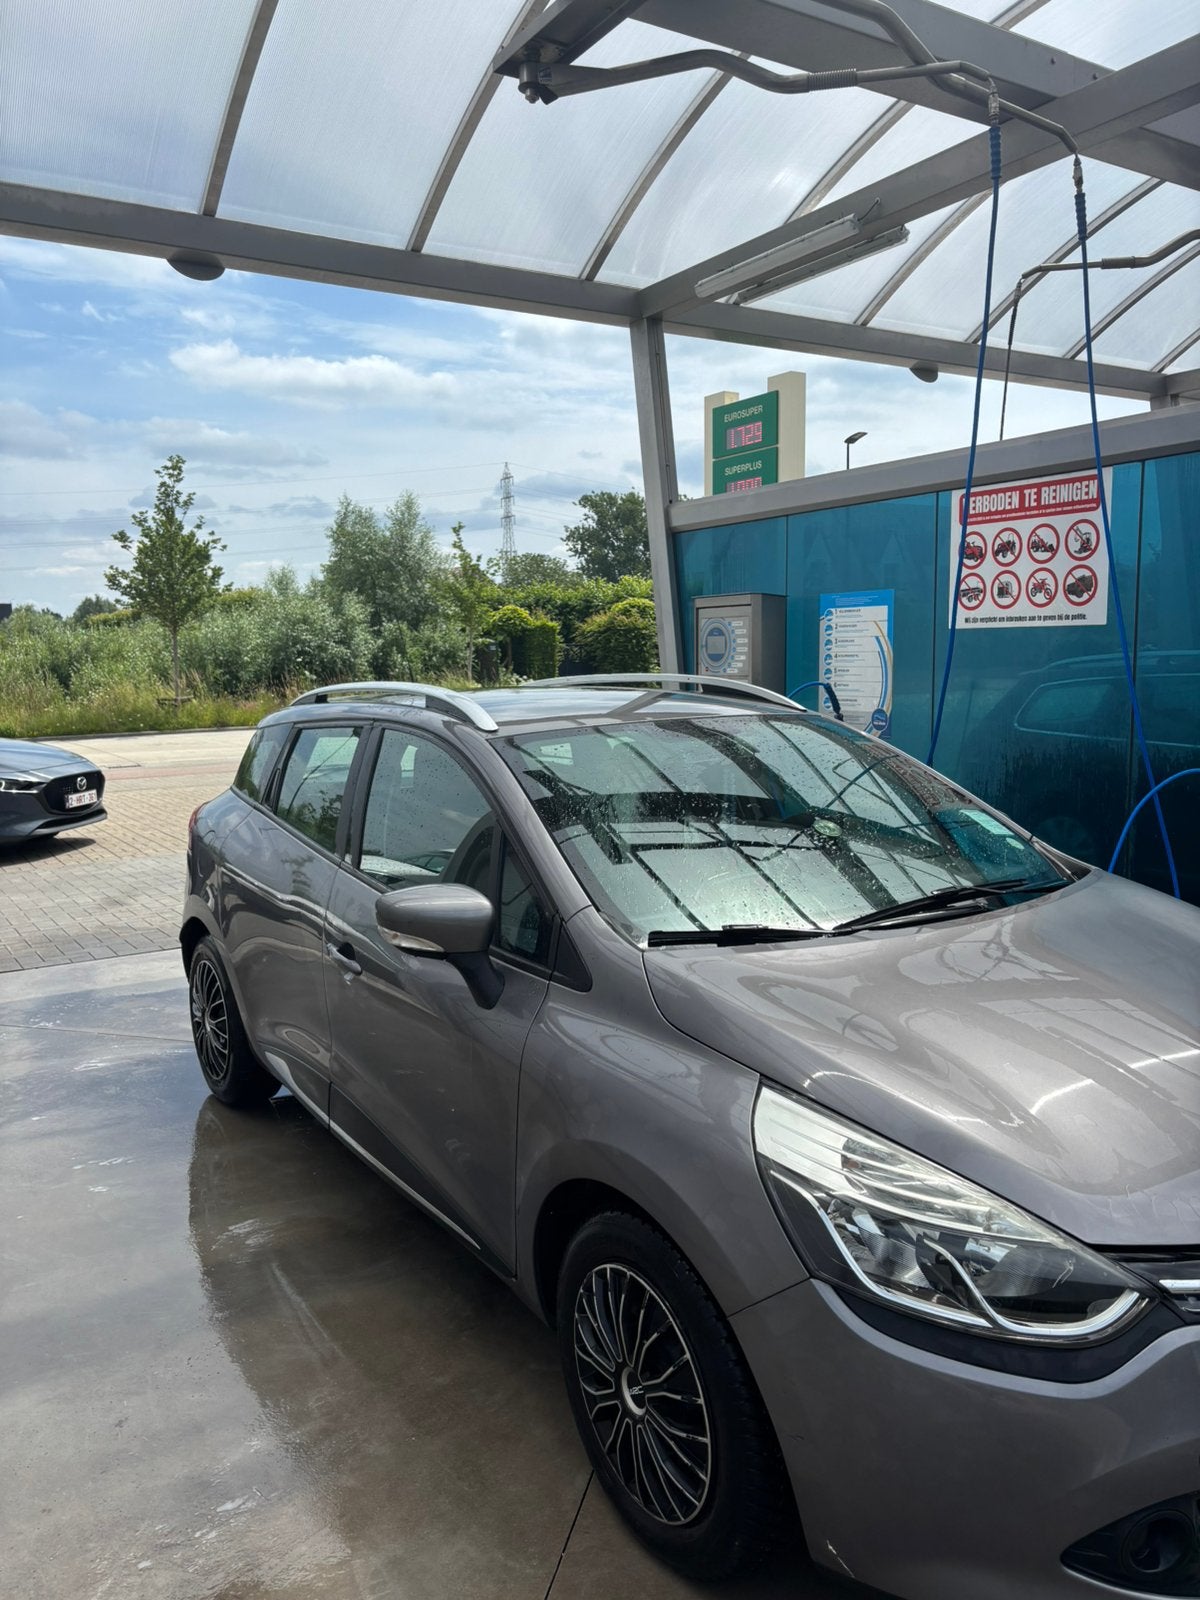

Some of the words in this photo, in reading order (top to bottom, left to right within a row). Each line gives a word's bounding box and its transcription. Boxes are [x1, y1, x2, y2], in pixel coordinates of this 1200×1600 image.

[724, 405, 763, 423] EUROSUPER
[724, 460, 762, 476] SUPERPLUS
[1024, 488, 1038, 508] TE
[1041, 479, 1098, 505] REINIGEN
